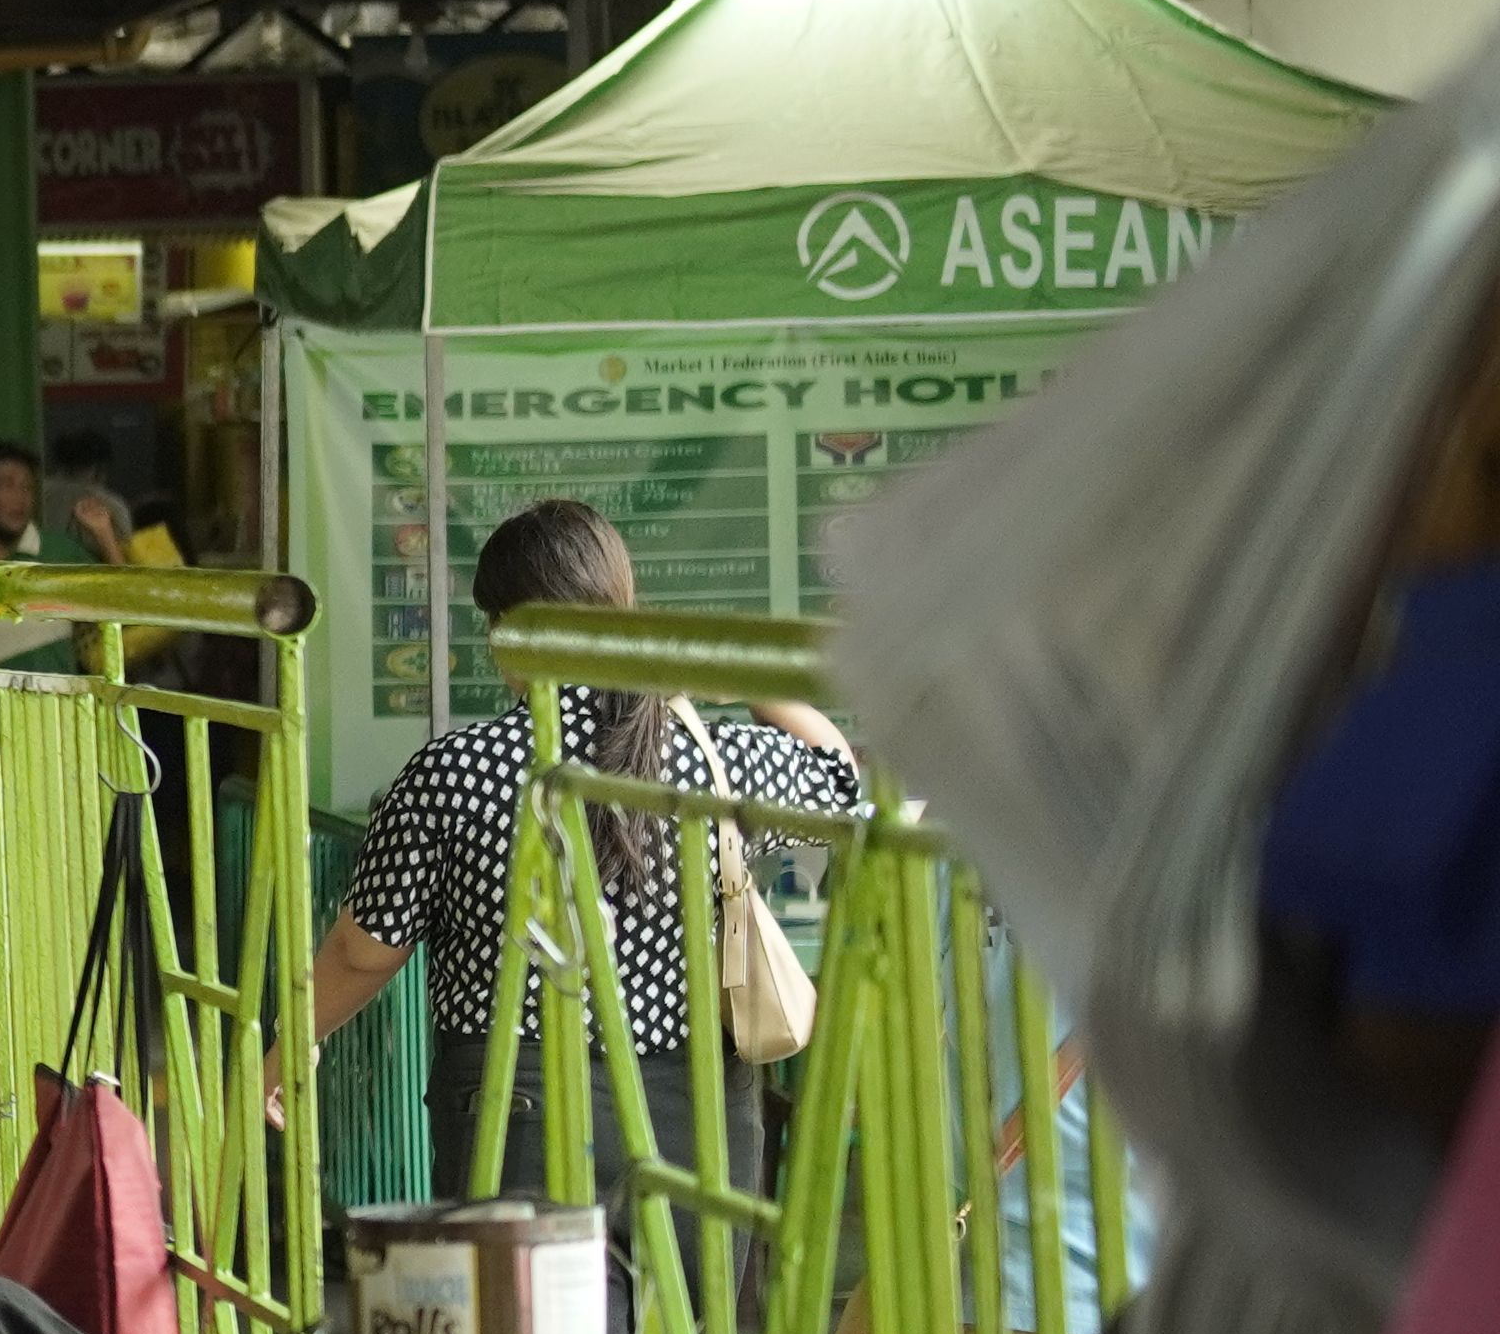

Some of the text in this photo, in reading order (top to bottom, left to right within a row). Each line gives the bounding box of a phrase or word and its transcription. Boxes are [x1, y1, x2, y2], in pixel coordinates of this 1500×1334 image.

[940, 193, 1246, 289] ASEAN
[643, 357, 703, 374] Market
[721, 353, 807, 372] Federation
[362, 378, 818, 420] EMERGENCY
[563, 444, 630, 461] Action
[633, 442, 704, 459] Center
